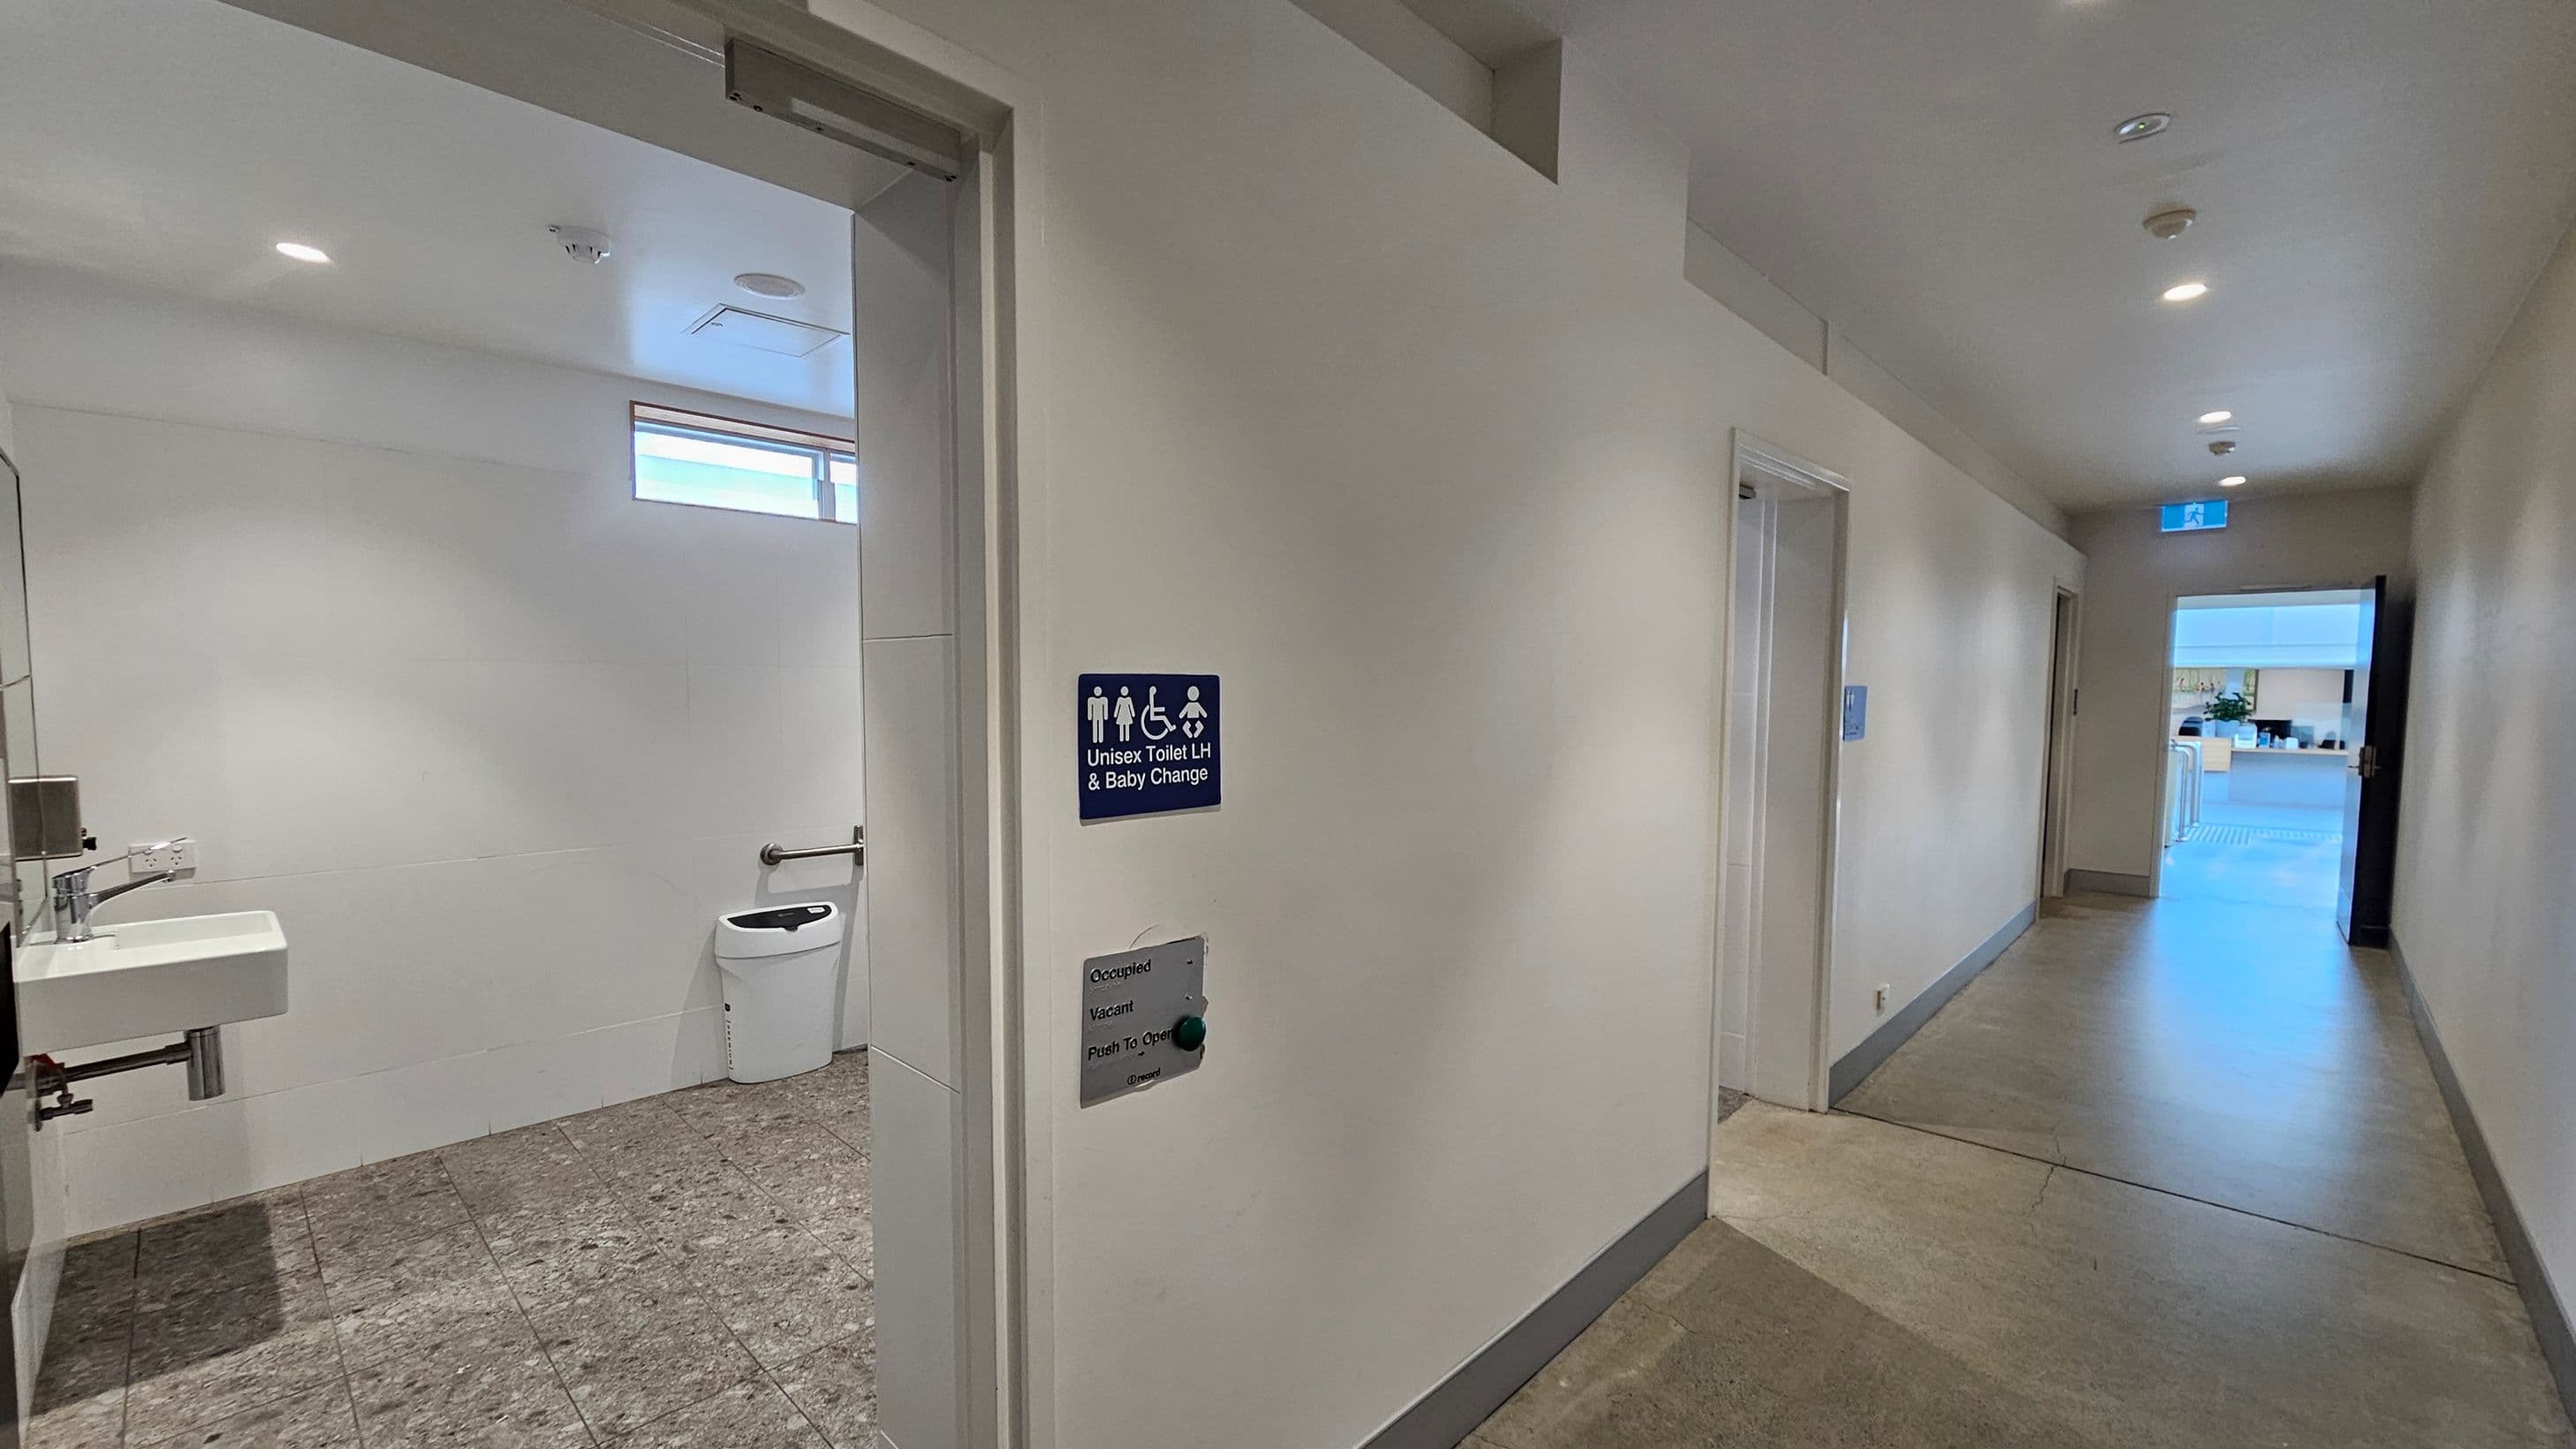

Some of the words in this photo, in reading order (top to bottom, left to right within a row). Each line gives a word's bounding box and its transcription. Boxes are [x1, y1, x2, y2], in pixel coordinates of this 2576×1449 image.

[1087, 747, 1142, 766] Unisex
[1146, 744, 1187, 762] Toilet
[1192, 742, 1211, 760] LH
[1088, 772, 1101, 791] &
[1105, 770, 1146, 791] Baby
[1150, 767, 1208, 785] Change
[1090, 959, 1152, 983] Occupied
[1089, 1000, 1134, 1021] Vacant
[1087, 1041, 1120, 1060] Push
[1123, 1036, 1138, 1051] To
[1137, 1067, 1161, 1083] record
